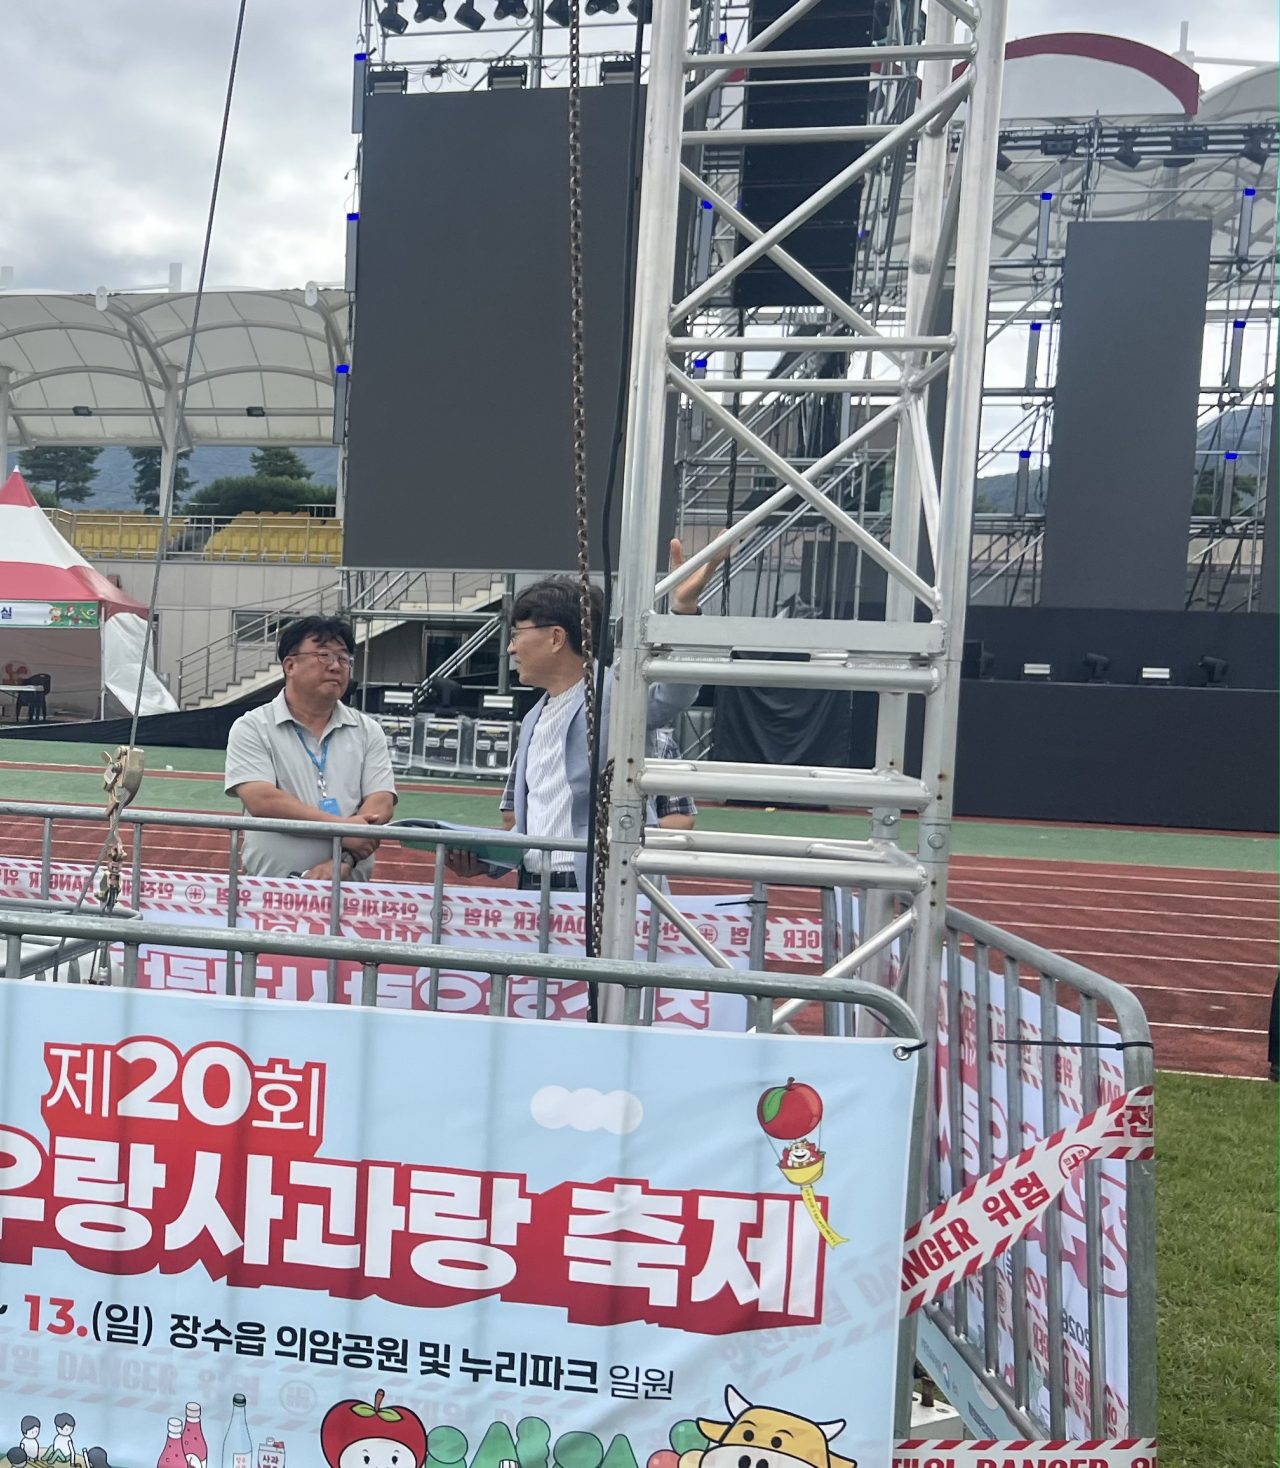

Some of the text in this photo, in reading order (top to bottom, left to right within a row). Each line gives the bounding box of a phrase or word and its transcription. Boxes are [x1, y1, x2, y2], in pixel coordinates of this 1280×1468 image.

[46, 1040, 322, 1137] 제20회
[981, 1170, 1051, 1228] 위험
[562, 1182, 823, 1318] 축제
[169, 1313, 267, 1358] 장수읍
[275, 1324, 409, 1376] 의암공원
[419, 1343, 453, 1378] 및
[460, 1348, 599, 1395] 누리파크
[609, 1363, 674, 1401] 일원
